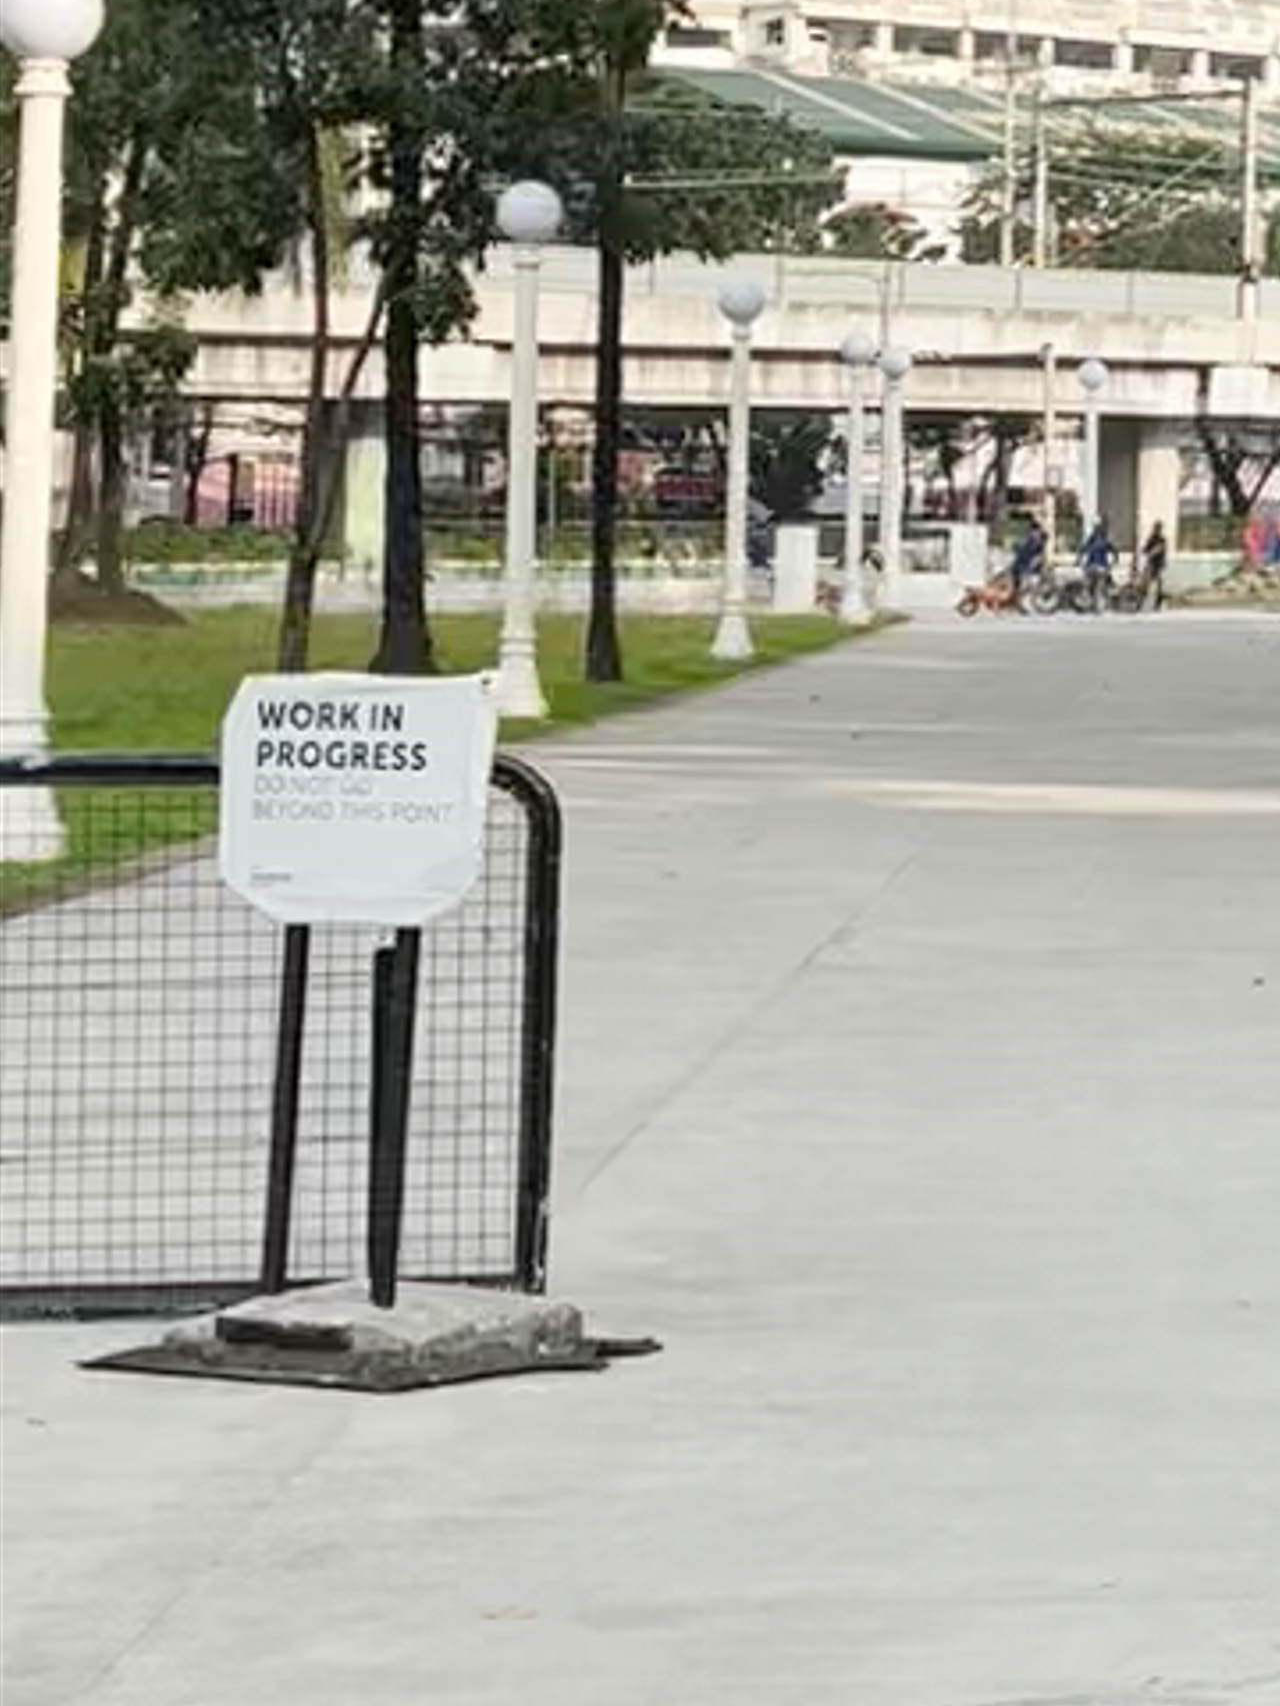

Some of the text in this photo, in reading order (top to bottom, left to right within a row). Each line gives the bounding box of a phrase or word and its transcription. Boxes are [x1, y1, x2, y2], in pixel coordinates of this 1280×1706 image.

[257, 701, 405, 732] WORK IN
[256, 739, 428, 771] PROGRESS
[254, 774, 373, 796] DO NOT GO
[254, 800, 454, 824] BEYOND THIS POINT
